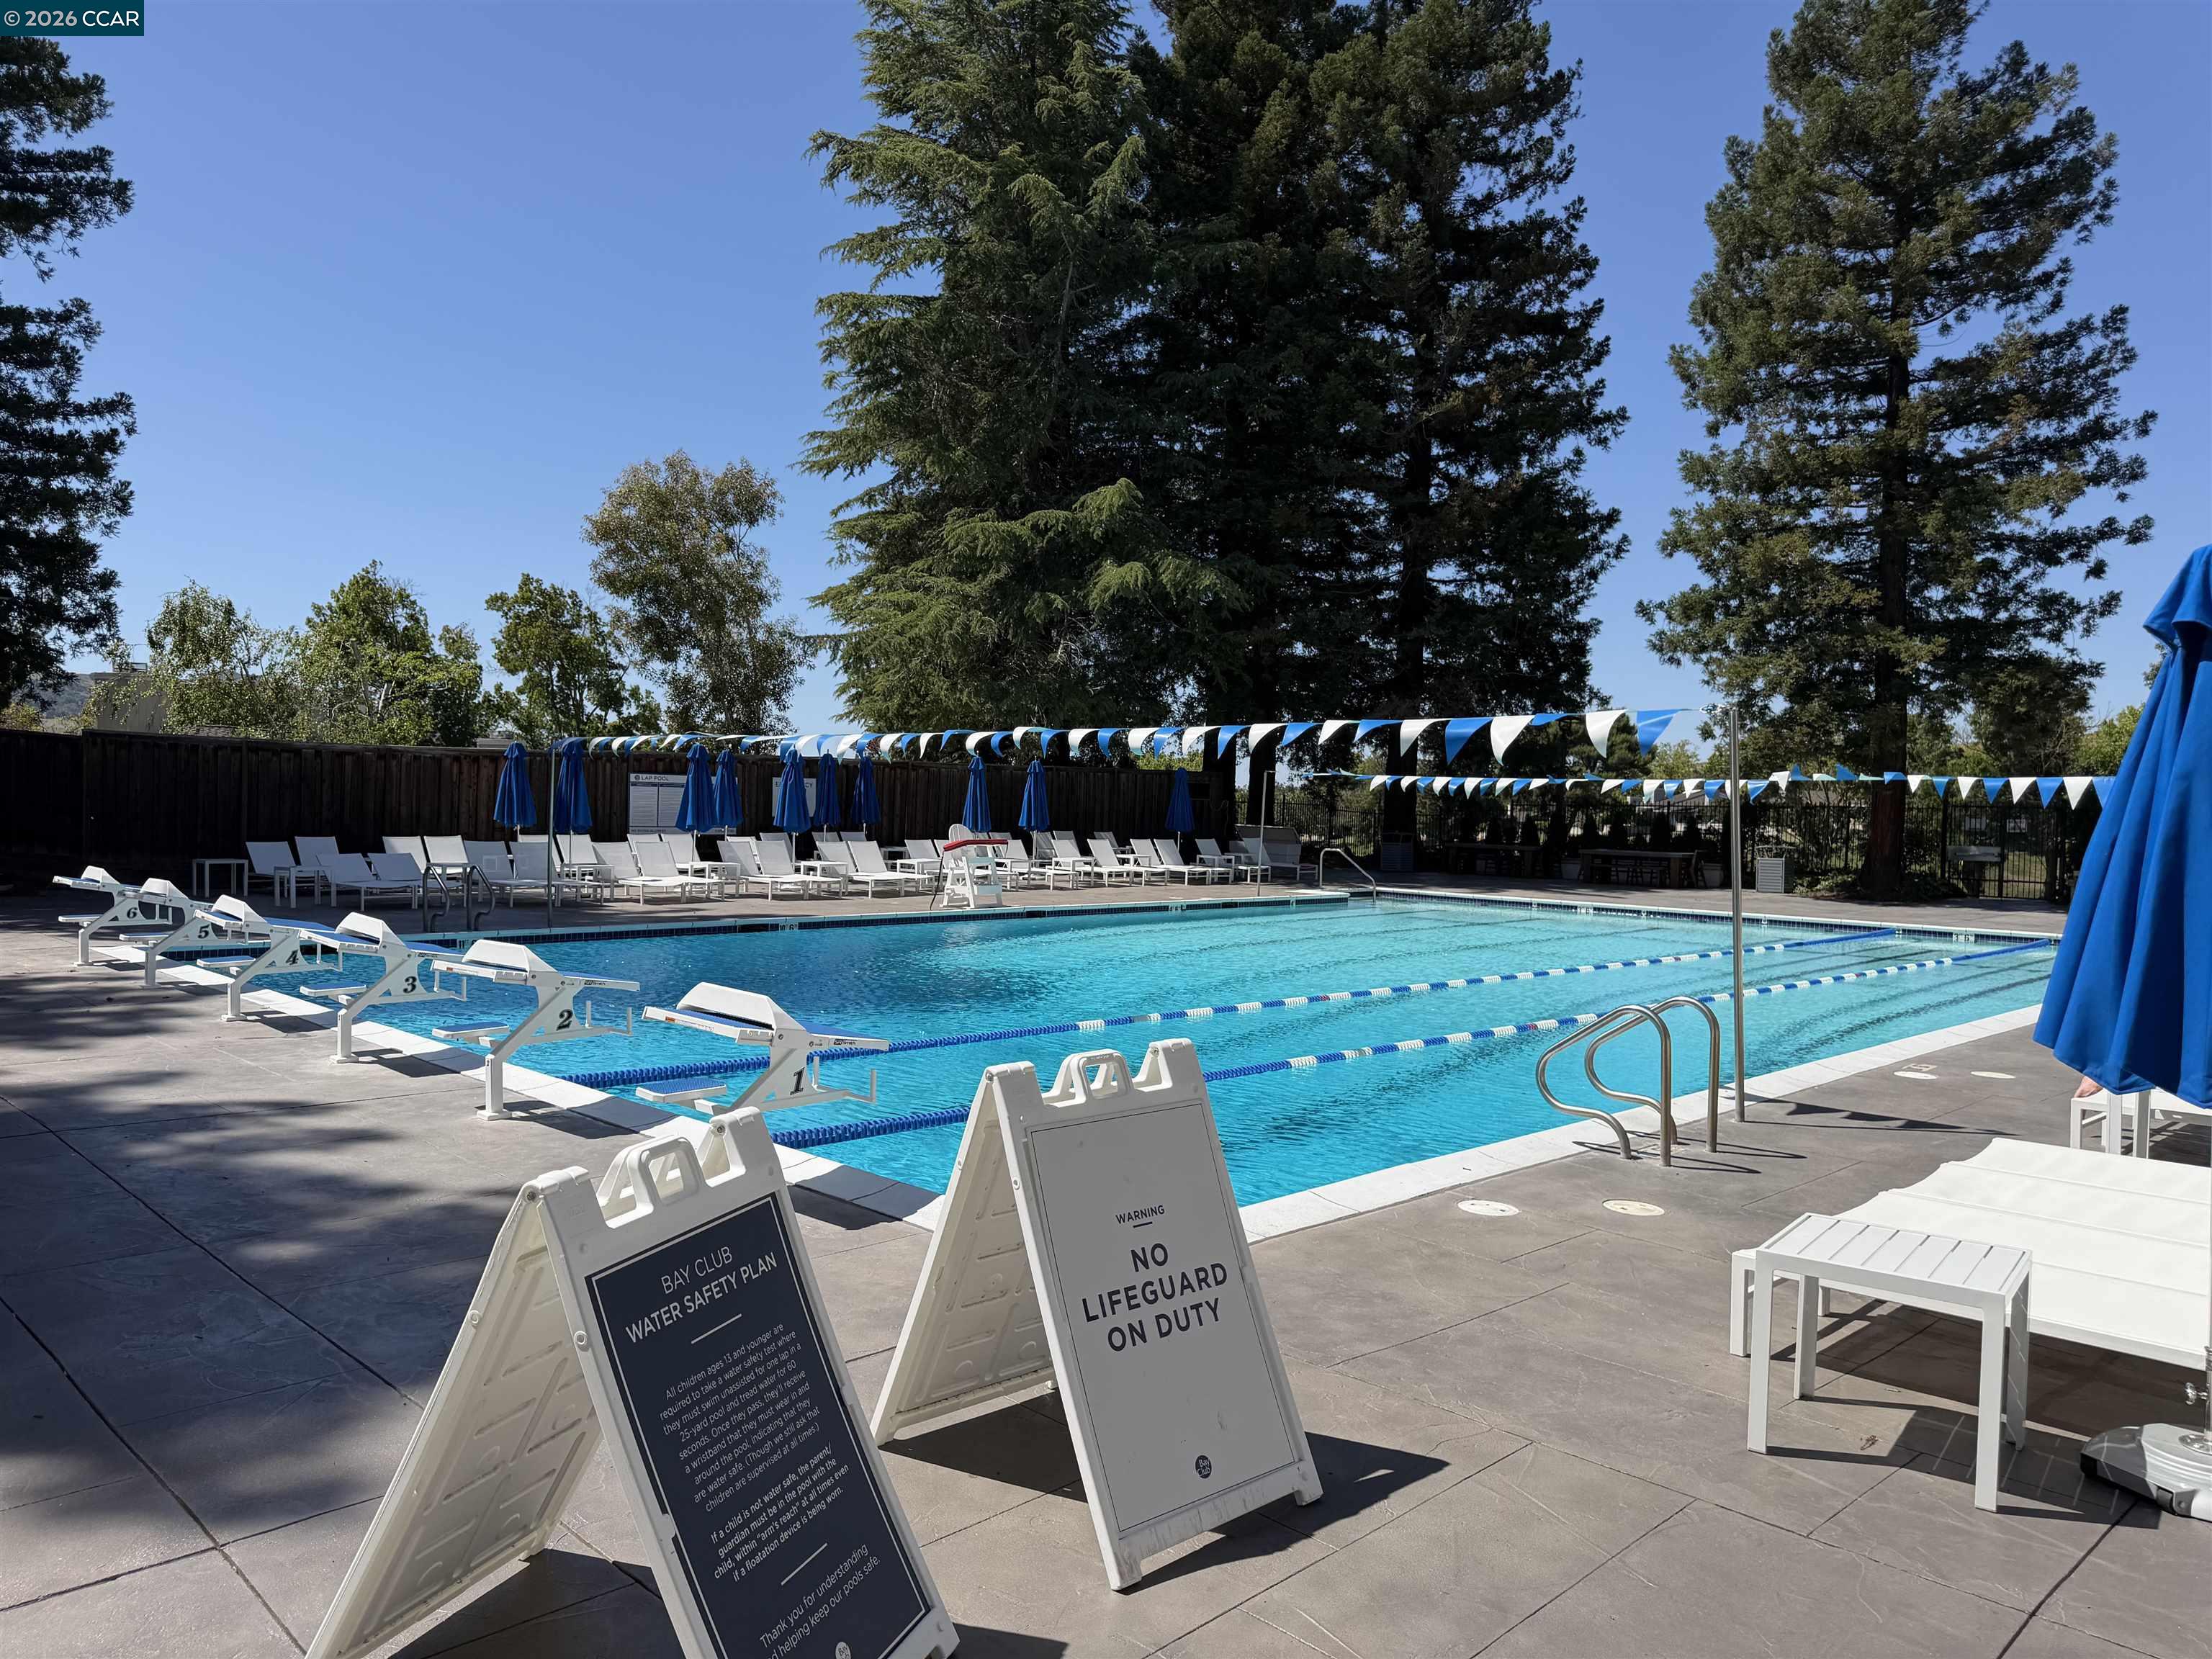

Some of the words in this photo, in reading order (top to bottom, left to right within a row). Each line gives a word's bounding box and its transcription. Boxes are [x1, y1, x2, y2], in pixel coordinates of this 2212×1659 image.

[126, 907, 138, 920] 6
[197, 925, 210, 940] 5
[285, 950, 299, 966] 4
[403, 976, 418, 994] 3
[557, 1009, 573, 1031] 2
[790, 1066, 806, 1096] 1
[1115, 1205, 1165, 1224] WARNING
[660, 1264, 690, 1294] BAY
[694, 1246, 732, 1276] CLUB
[1082, 1263, 1227, 1322] LIFEGUARD
[1130, 1243, 1168, 1272] NO
[625, 1302, 683, 1343] WATER
[683, 1271, 737, 1313] SAFETY
[739, 1251, 777, 1283] PLAN
[1107, 1320, 1147, 1352] ON
[1155, 1298, 1219, 1339] DUTY
[660, 1393, 691, 1420] required
[691, 1390, 700, 1400] to
[700, 1380, 716, 1394] take
[717, 1376, 723, 1385] a
[723, 1363, 742, 1380] water
[742, 1351, 763, 1368] safety
[763, 1341, 777, 1355] test
[776, 1331, 796, 1346] where
[662, 1419, 680, 1435] they
[681, 1406, 701, 1423] must
[701, 1394, 720, 1411] swim
[720, 1370, 755, 1399] unassisted
[755, 1364, 765, 1376] for
[765, 1357, 778, 1370] one
[778, 1350, 789, 1361] lap
[666, 1385, 676, 1400] All
[677, 1370, 706, 1393] children
[706, 1359, 724, 1375] ages
[723, 1352, 732, 1364] 13
[732, 1344, 746, 1359] and
[745, 1330, 772, 1353] younger
[773, 1323, 783, 1334] are
[679, 1416, 709, 1442] 25-yard
[709, 1405, 725, 1424] pool
[725, 1395, 739, 1411] and
[739, 1384, 757, 1403] tread
[757, 1373, 776, 1390] water
[776, 1367, 786, 1377] for
[786, 1359, 796, 1371] 60
[685, 1465, 691, 1473] a
[691, 1437, 727, 1468] wristband
[726, 1428, 742, 1444] that
[741, 1419, 757, 1434] they
[757, 1406, 775, 1423] must
[774, 1395, 789, 1411] wear
[789, 1391, 798, 1400] in
[797, 1380, 809, 1395] and
[711, 1421, 730, 1437] Once
[730, 1409, 746, 1424] they
[783, 1370, 806, 1388] receive
[693, 1489, 706, 1503] are
[706, 1473, 727, 1492] water
[773, 1433, 783, 1444] we
[783, 1422, 795, 1437] still
[795, 1415, 806, 1429] ask
[806, 1405, 819, 1420] that
[694, 1459, 720, 1485] around
[719, 1452, 733, 1465] the
[750, 1417, 783, 1444] indicating
[782, 1406, 796, 1421] that
[796, 1397, 810, 1411] they
[706, 1486, 734, 1511] children
[734, 1477, 746, 1490] are
[746, 1447, 782, 1480] supervised
[782, 1444, 790, 1455] at
[789, 1437, 798, 1449] all
[710, 1531, 718, 1544] If
[718, 1529, 724, 1538] a
[724, 1512, 742, 1533] child
[742, 1509, 750, 1519] is
[750, 1498, 763, 1514] not
[762, 1483, 781, 1503] water
[797, 1462, 809, 1475] the
[718, 1527, 750, 1558] guardian
[750, 1511, 768, 1532] must
[766, 1505, 777, 1517] be
[776, 1499, 785, 1509] in
[784, 1490, 796, 1503] the
[796, 1475, 811, 1496] pool
[811, 1465, 826, 1481] with
[824, 1458, 836, 1470] the
[732, 1569, 739, 1581] if
[739, 1567, 746, 1576] a
[745, 1539, 779, 1571] floatation
[779, 1521, 801, 1542] device
[800, 1515, 808, 1524] is
[806, 1500, 826, 1519] being
[734, 1539, 757, 1561] within
[801, 1496, 809, 1507] at
[808, 1488, 817, 1501] all
[816, 1476, 834, 1493] times
[834, 1464, 849, 1480] even
[759, 1619, 788, 1647] Thank
[786, 1604, 804, 1627] you
[802, 1591, 815, 1608] for
[816, 1544, 868, 1596] understanding
[777, 1622, 810, 1656] helping
[808, 1604, 829, 1627] keep
[830, 1589, 842, 1607] our
[842, 1570, 863, 1596] pools
